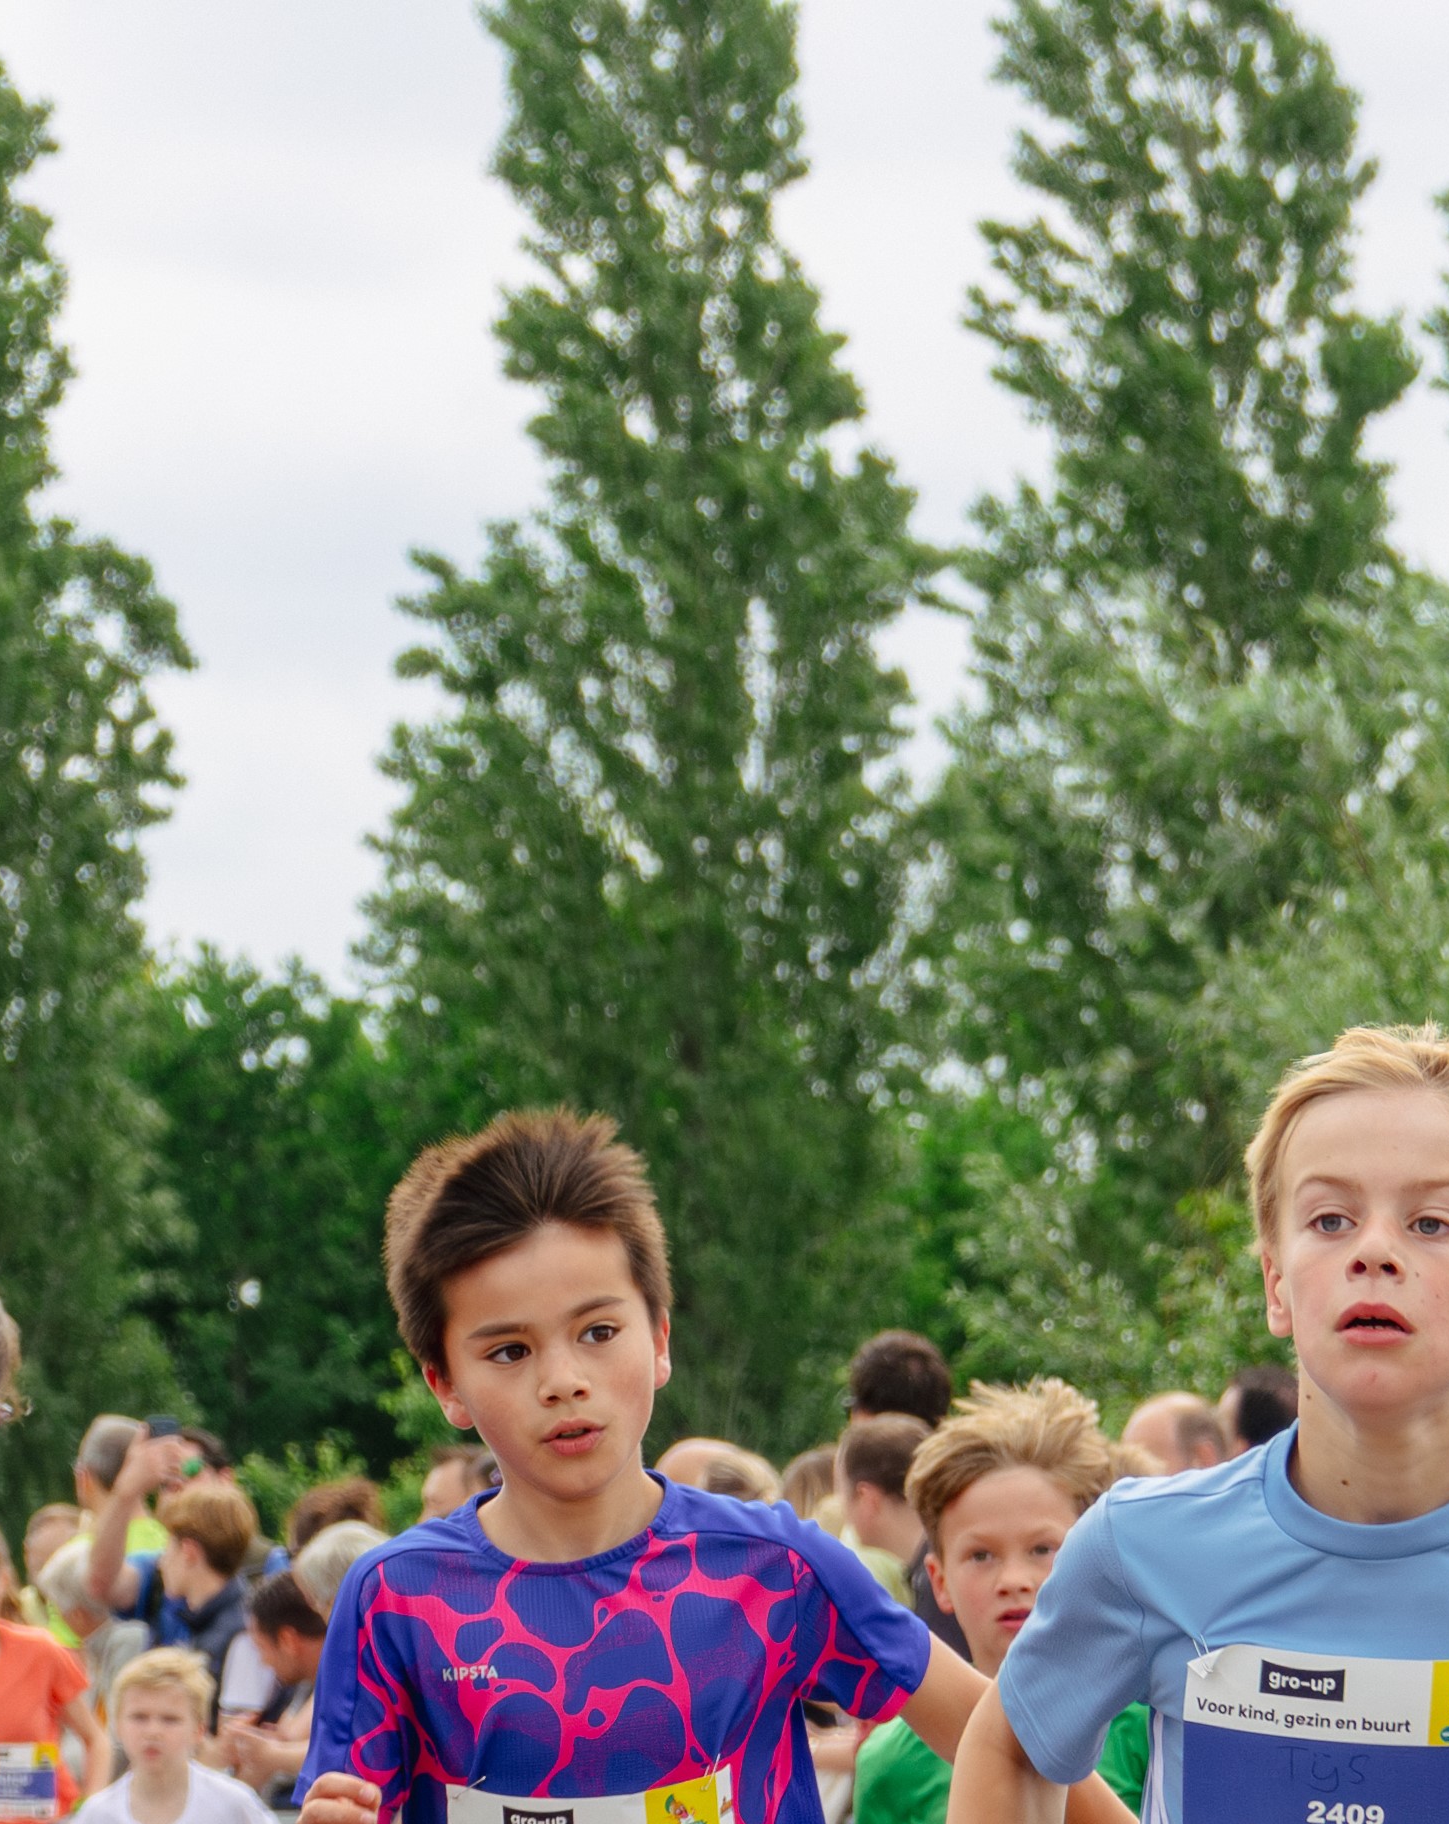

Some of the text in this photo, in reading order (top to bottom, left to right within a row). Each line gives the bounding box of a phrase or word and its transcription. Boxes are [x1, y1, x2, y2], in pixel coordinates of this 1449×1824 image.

[442, 1665, 499, 1682] KIPSTA
[1268, 1671, 1336, 1694] gro-up
[1196, 1697, 1411, 1733] Voor kind, gezin en buurt
